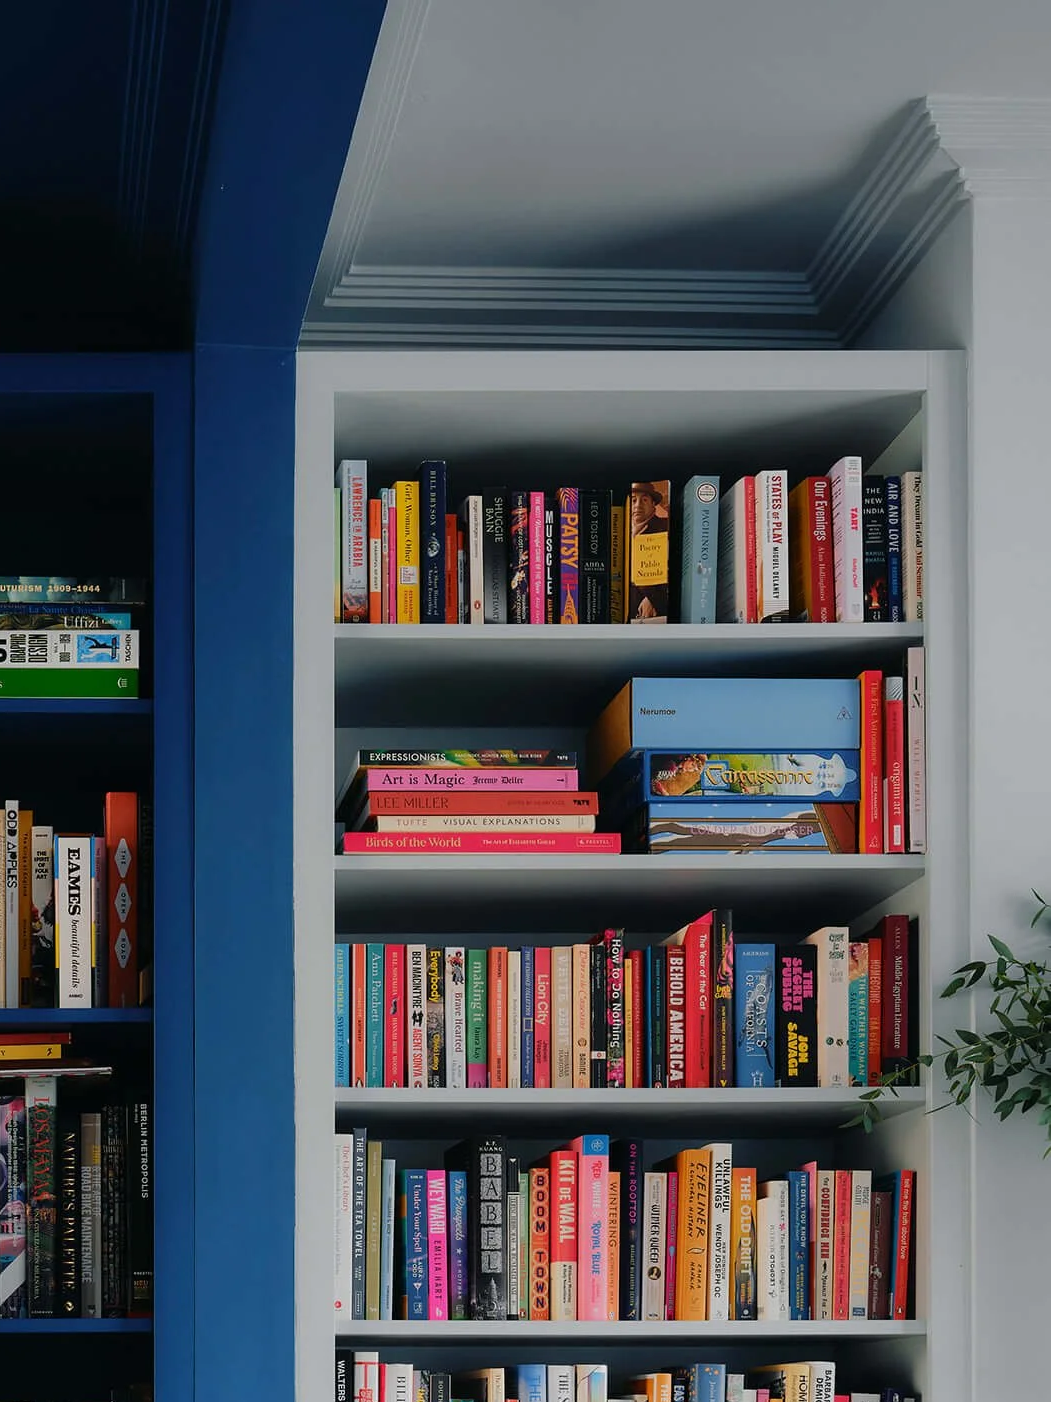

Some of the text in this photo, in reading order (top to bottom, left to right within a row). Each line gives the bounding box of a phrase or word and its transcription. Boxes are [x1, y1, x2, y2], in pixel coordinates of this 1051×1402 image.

[486, 508, 494, 532] BAIN
[494, 497, 504, 542] SHUGGIE
[560, 513, 578, 568] PATSY
[701, 509, 709, 560] PACHINKO
[888, 483, 899, 552] AIR AND LOVE
[10, 634, 26, 663] GRAPHIC
[28, 634, 48, 663] DESIGN
[370, 753, 446, 761] EXPRESSIONISTS
[382, 774, 405, 784] Art
[409, 774, 419, 784] is
[424, 774, 465, 788] Magic
[501, 776, 523, 784] Deller
[377, 797, 449, 809] LEE MILLER
[366, 837, 461, 847] Birds of the World
[68, 848, 80, 988] EAMES beautiful details
[536, 974, 548, 1024] Lion City
[610, 939, 621, 1047] How to Do Nothing
[700, 969, 706, 978] of
[782, 957, 791, 1012] PUBLIC
[792, 957, 802, 1013] SECRET
[803, 970, 813, 998] THE
[412, 951, 422, 1077] BEN MACINTYRE AGENT SONYA
[455, 992, 463, 1052] Brave Hearted
[669, 957, 684, 1081] BEHOLD AMERICA
[699, 995, 707, 1010] Cat
[756, 983, 766, 1048] COASTS
[787, 1022, 798, 1076] SAVAGE
[799, 1035, 808, 1063] JON
[140, 1104, 148, 1199] BERLIN METROPOLIS
[356, 1177, 363, 1186] OF
[413, 1185, 421, 1211] Under
[696, 1163, 707, 1238] EYELINER
[722, 1159, 730, 1213] UNLAWFUL
[81, 1166, 92, 1283] ROAD BIKE MAINTENANCE
[481, 1155, 501, 1272] BABEL
[608, 1182, 617, 1247] WINTERING
[740, 1175, 751, 1274] THE OLD DRIFT
[355, 1230, 363, 1258] TOWEL
[412, 1232, 422, 1252] Spell
[536, 1176, 545, 1308] BOOM TOWN
[714, 1286, 721, 1298] QC
[338, 1360, 346, 1401] WALTERS
[529, 1375, 541, 1401] THE
